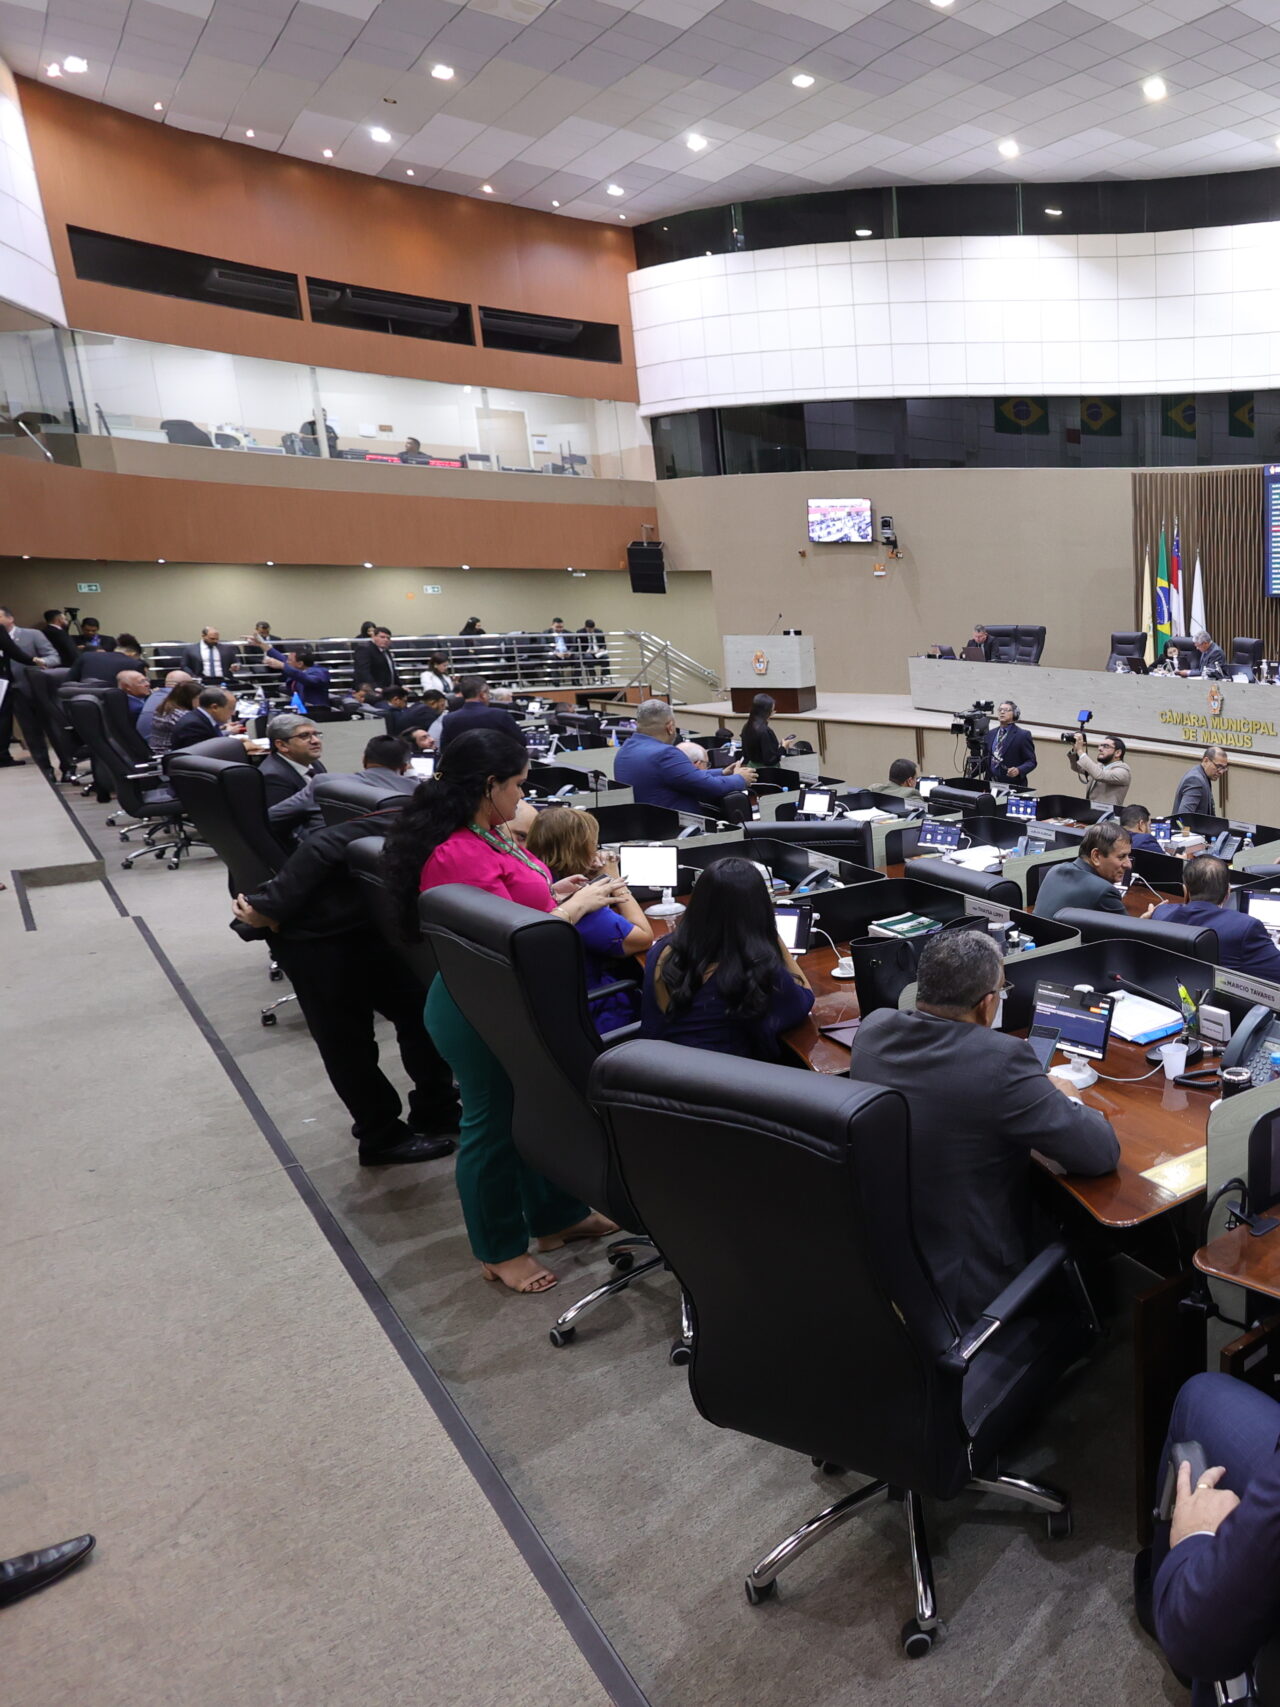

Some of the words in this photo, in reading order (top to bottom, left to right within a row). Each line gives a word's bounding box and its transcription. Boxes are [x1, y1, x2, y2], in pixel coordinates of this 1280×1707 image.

[1158, 709, 1208, 728] CÂMARA
[1210, 716, 1278, 736] MUNICIPAL
[1182, 728, 1197, 741] DE
[1201, 730, 1253, 748] MANAUS
[1250, 988, 1276, 1002] TAVARES
